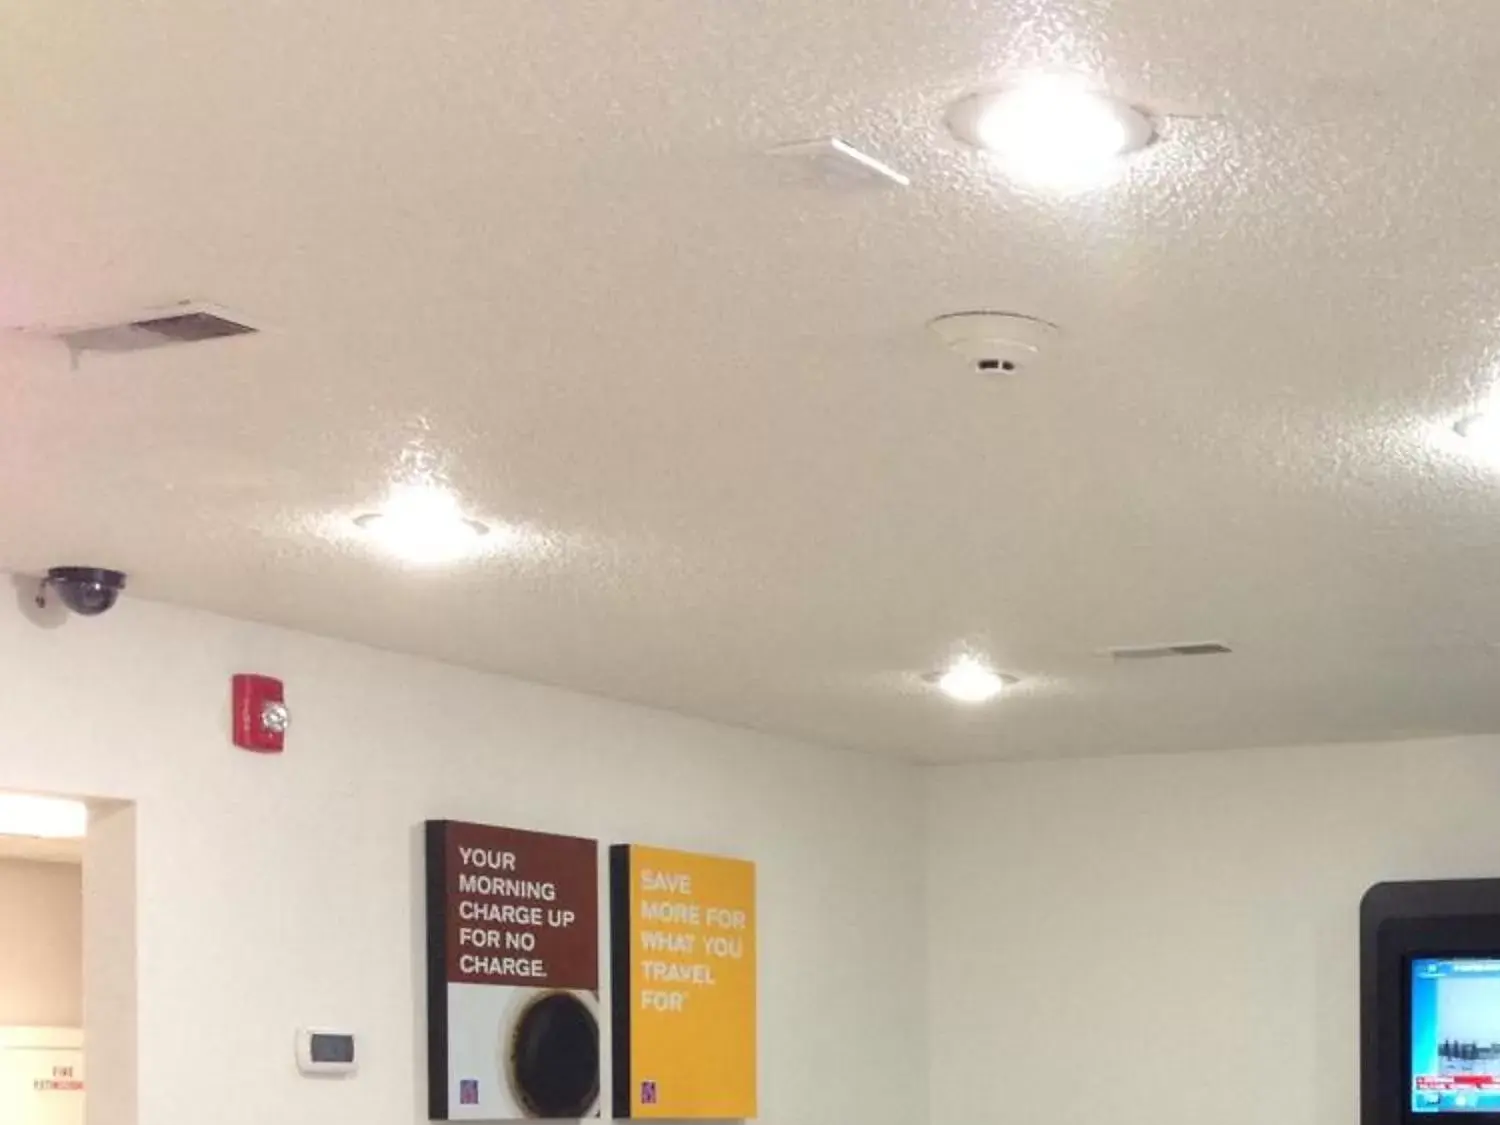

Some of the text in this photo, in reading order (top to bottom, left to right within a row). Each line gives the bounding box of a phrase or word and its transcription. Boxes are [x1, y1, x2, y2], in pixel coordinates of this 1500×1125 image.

[459, 847, 516, 871] YOUR
[459, 874, 556, 901] MORNING
[641, 868, 691, 894] SAVE
[459, 900, 575, 927] CHARGE UP
[641, 899, 746, 929] MORE FOR
[459, 927, 535, 951] FOR NO
[641, 930, 742, 959] WHAT YOU
[459, 954, 548, 977] CHARGE.
[641, 960, 716, 986] TRAVEL
